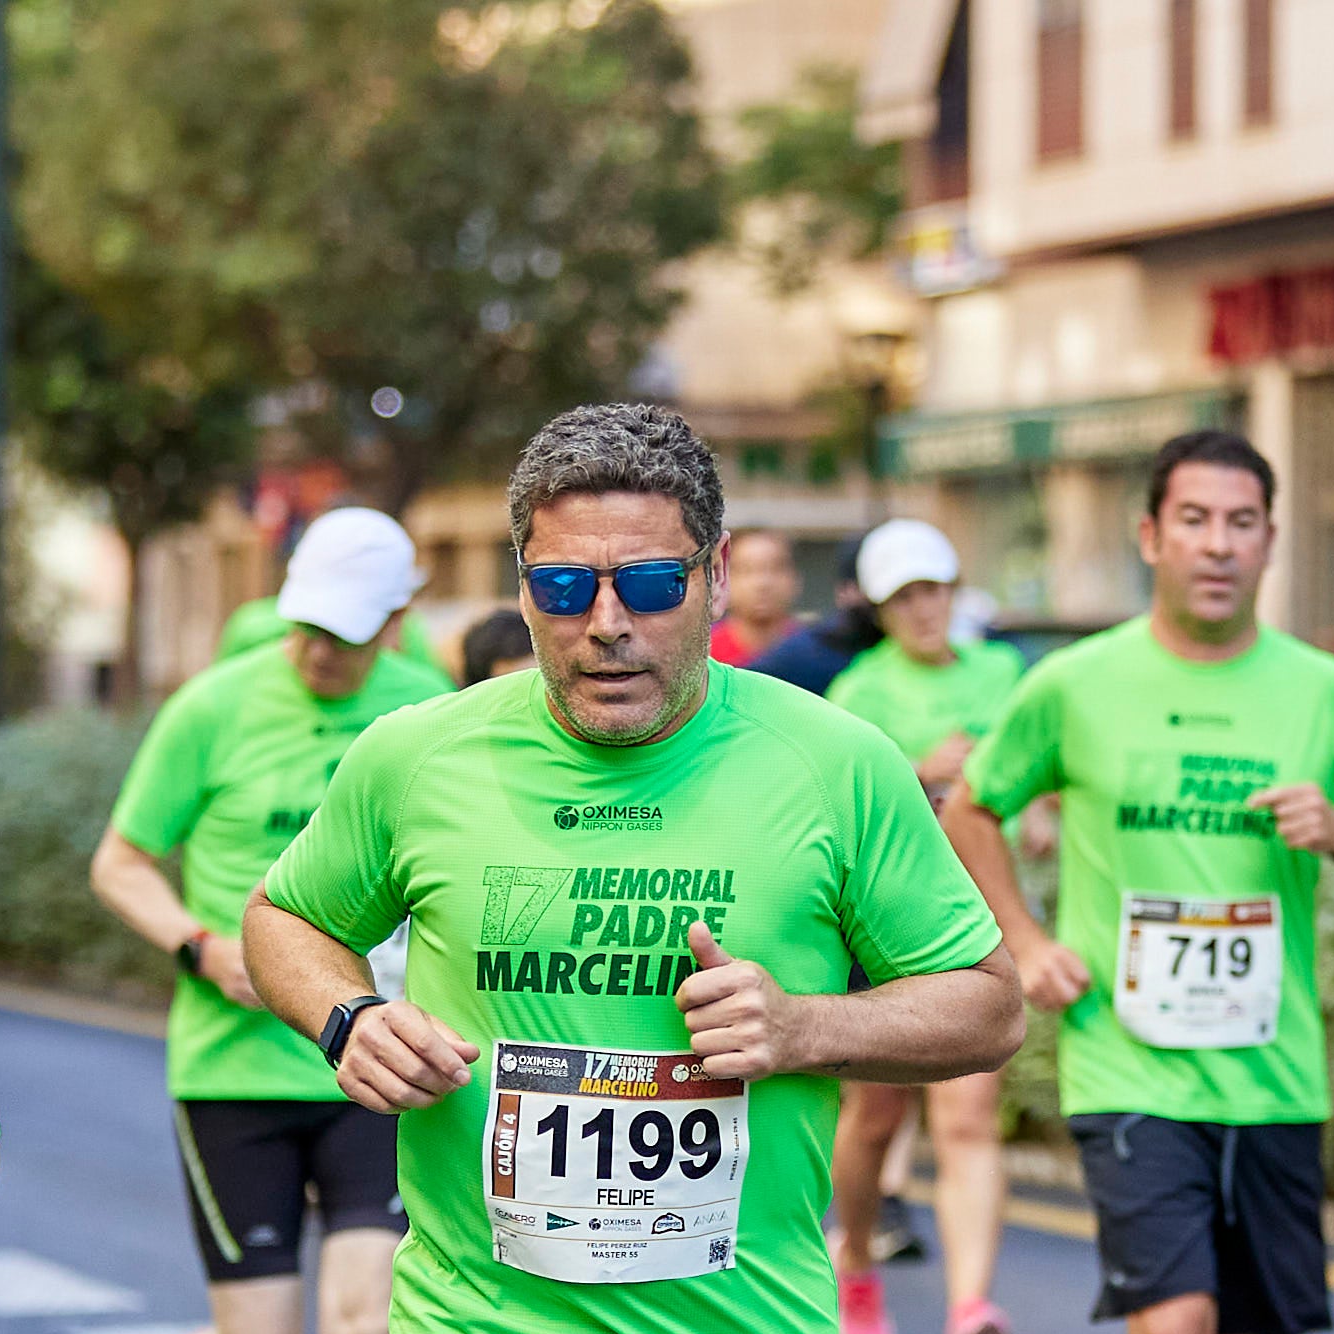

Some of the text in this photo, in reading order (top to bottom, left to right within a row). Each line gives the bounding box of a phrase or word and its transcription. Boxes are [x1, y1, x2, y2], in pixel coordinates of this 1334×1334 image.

[582, 806, 663, 820] OXIMESA
[581, 822, 663, 831] NIPPON GASES
[569, 868, 736, 904] MEMORIAL
[480, 866, 573, 946] 17
[570, 904, 727, 949] PADRE
[1168, 935, 1253, 979] 719
[518, 1055, 569, 1069] OXIMESA
[584, 1053, 611, 1079] 17
[609, 1055, 658, 1068] MEMORIAL
[517, 1067, 569, 1077] NIPPON GASES
[609, 1066, 655, 1082] PADRE
[579, 1078, 659, 1097] MARCELINO
[495, 1113, 517, 1176] CAJÓN 4
[536, 1104, 722, 1182] 1199
[596, 1188, 655, 1206] FELIPE
[603, 1218, 642, 1226] OXIMESA
[591, 1251, 627, 1259] MASTER
